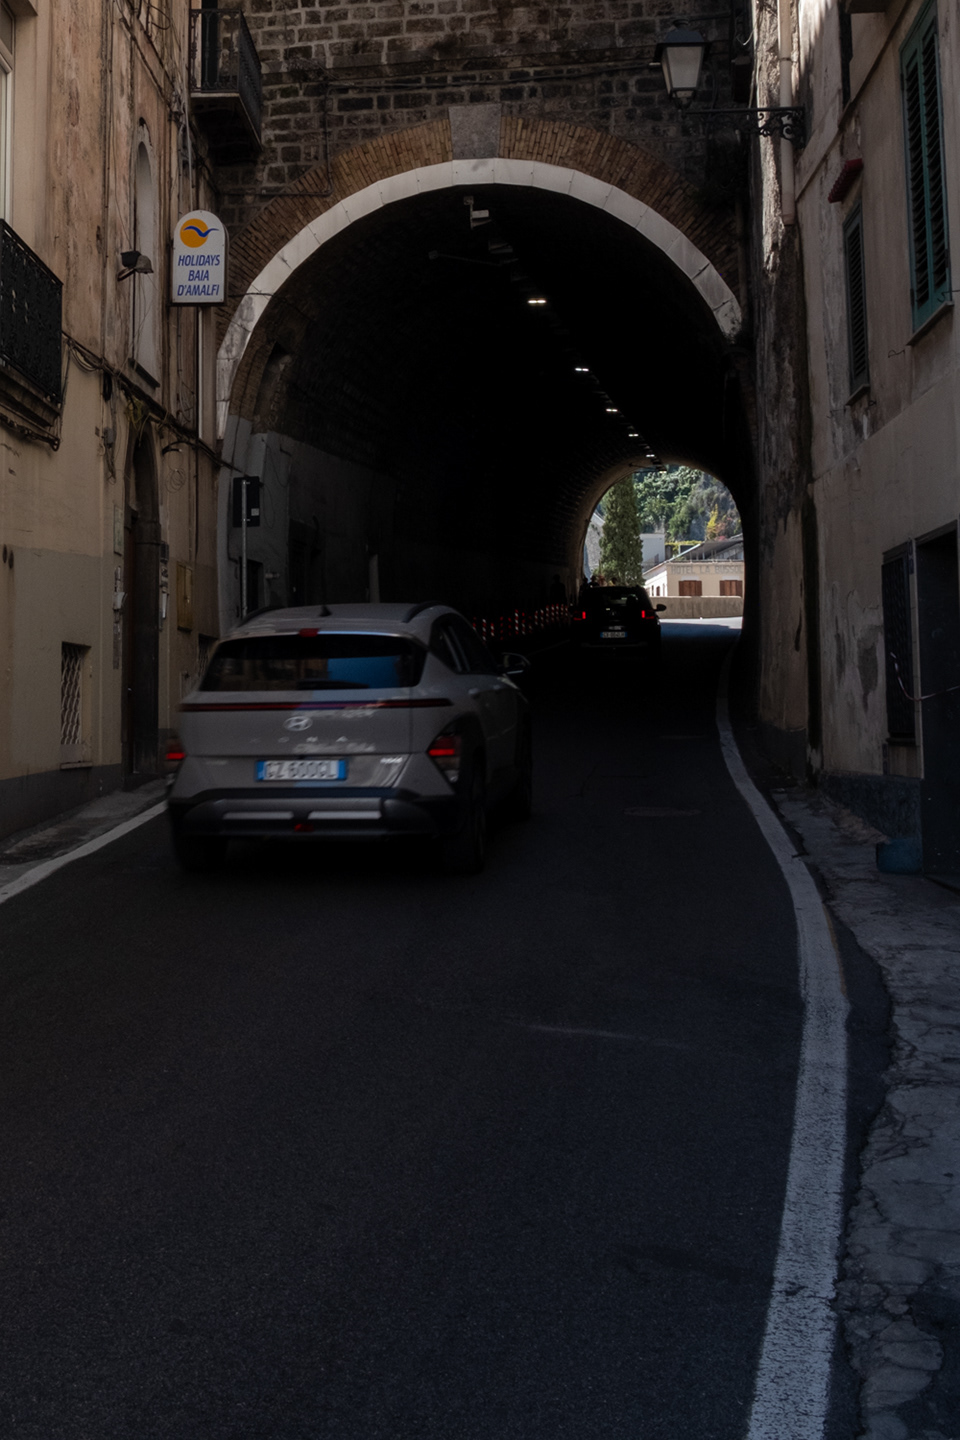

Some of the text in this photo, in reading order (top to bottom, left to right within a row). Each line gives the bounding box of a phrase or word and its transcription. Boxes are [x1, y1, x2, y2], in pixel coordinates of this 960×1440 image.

[178, 254, 220, 266] HOLIDAYS
[188, 269, 209, 281] BAIA
[177, 284, 220, 296] D'AMALFI
[671, 565, 694, 574] HOTEL
[700, 565, 710, 574] LA
